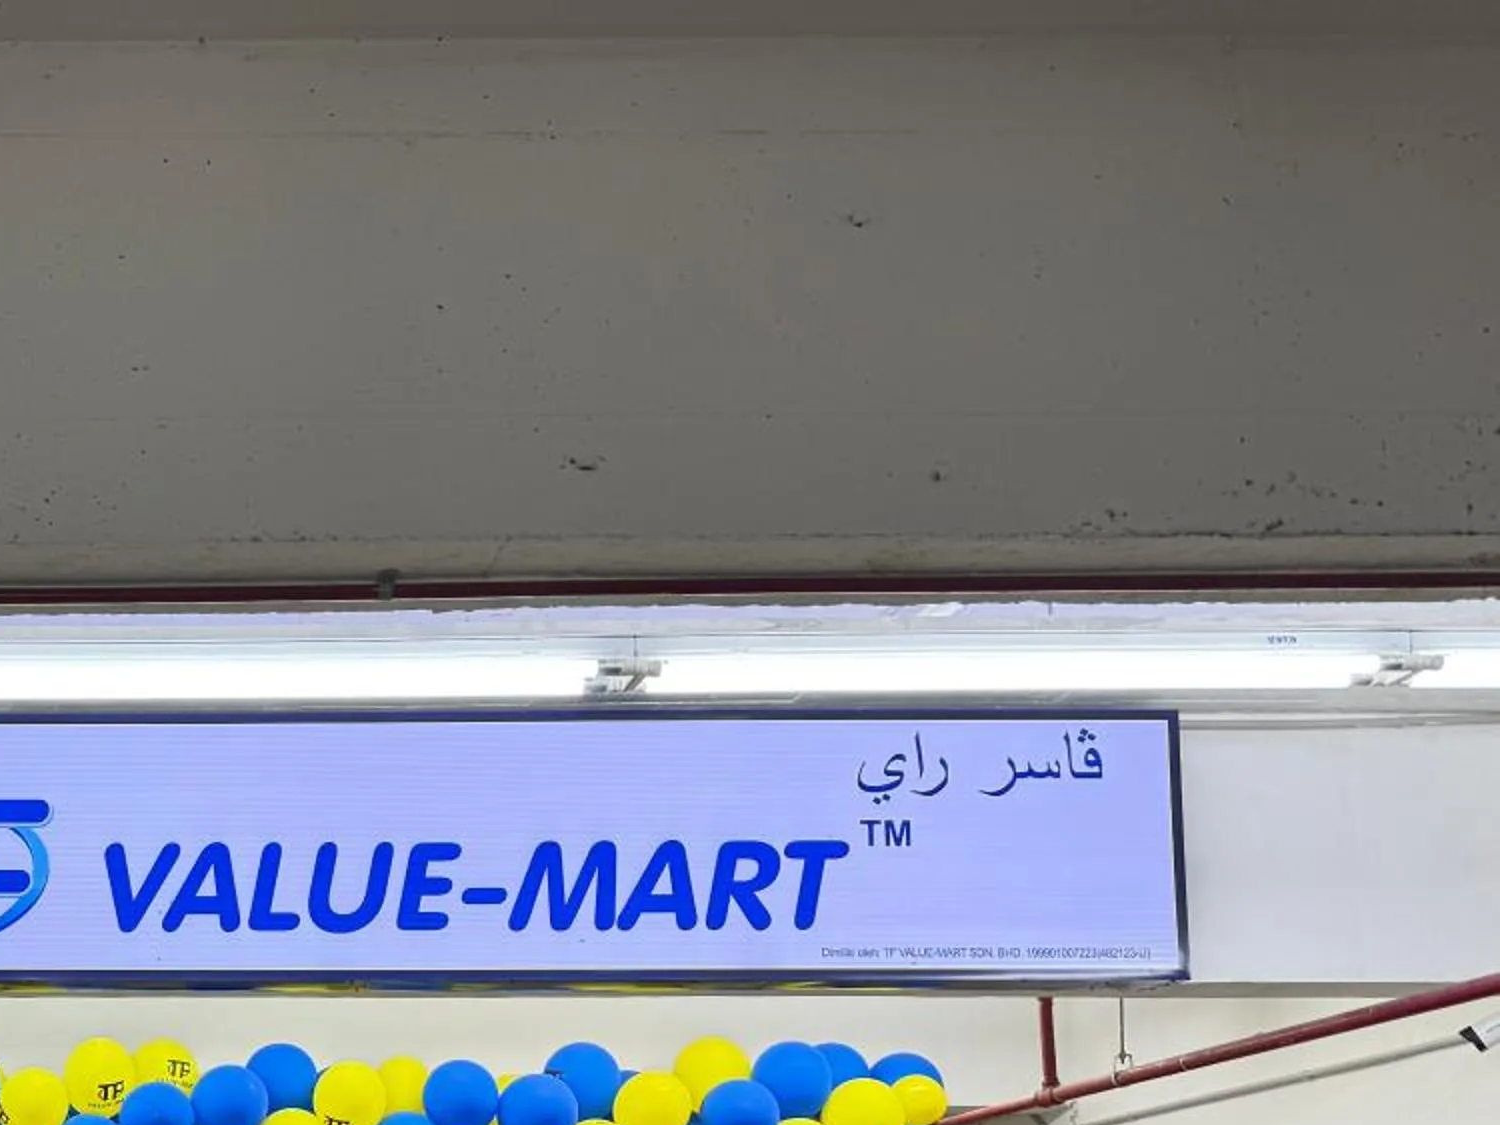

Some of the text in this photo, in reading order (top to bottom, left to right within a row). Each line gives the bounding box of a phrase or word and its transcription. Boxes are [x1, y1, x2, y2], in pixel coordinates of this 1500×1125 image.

[857, 731, 949, 804] راي
[104, 839, 849, 934] VALUE-MART
[860, 820, 912, 847] TM
